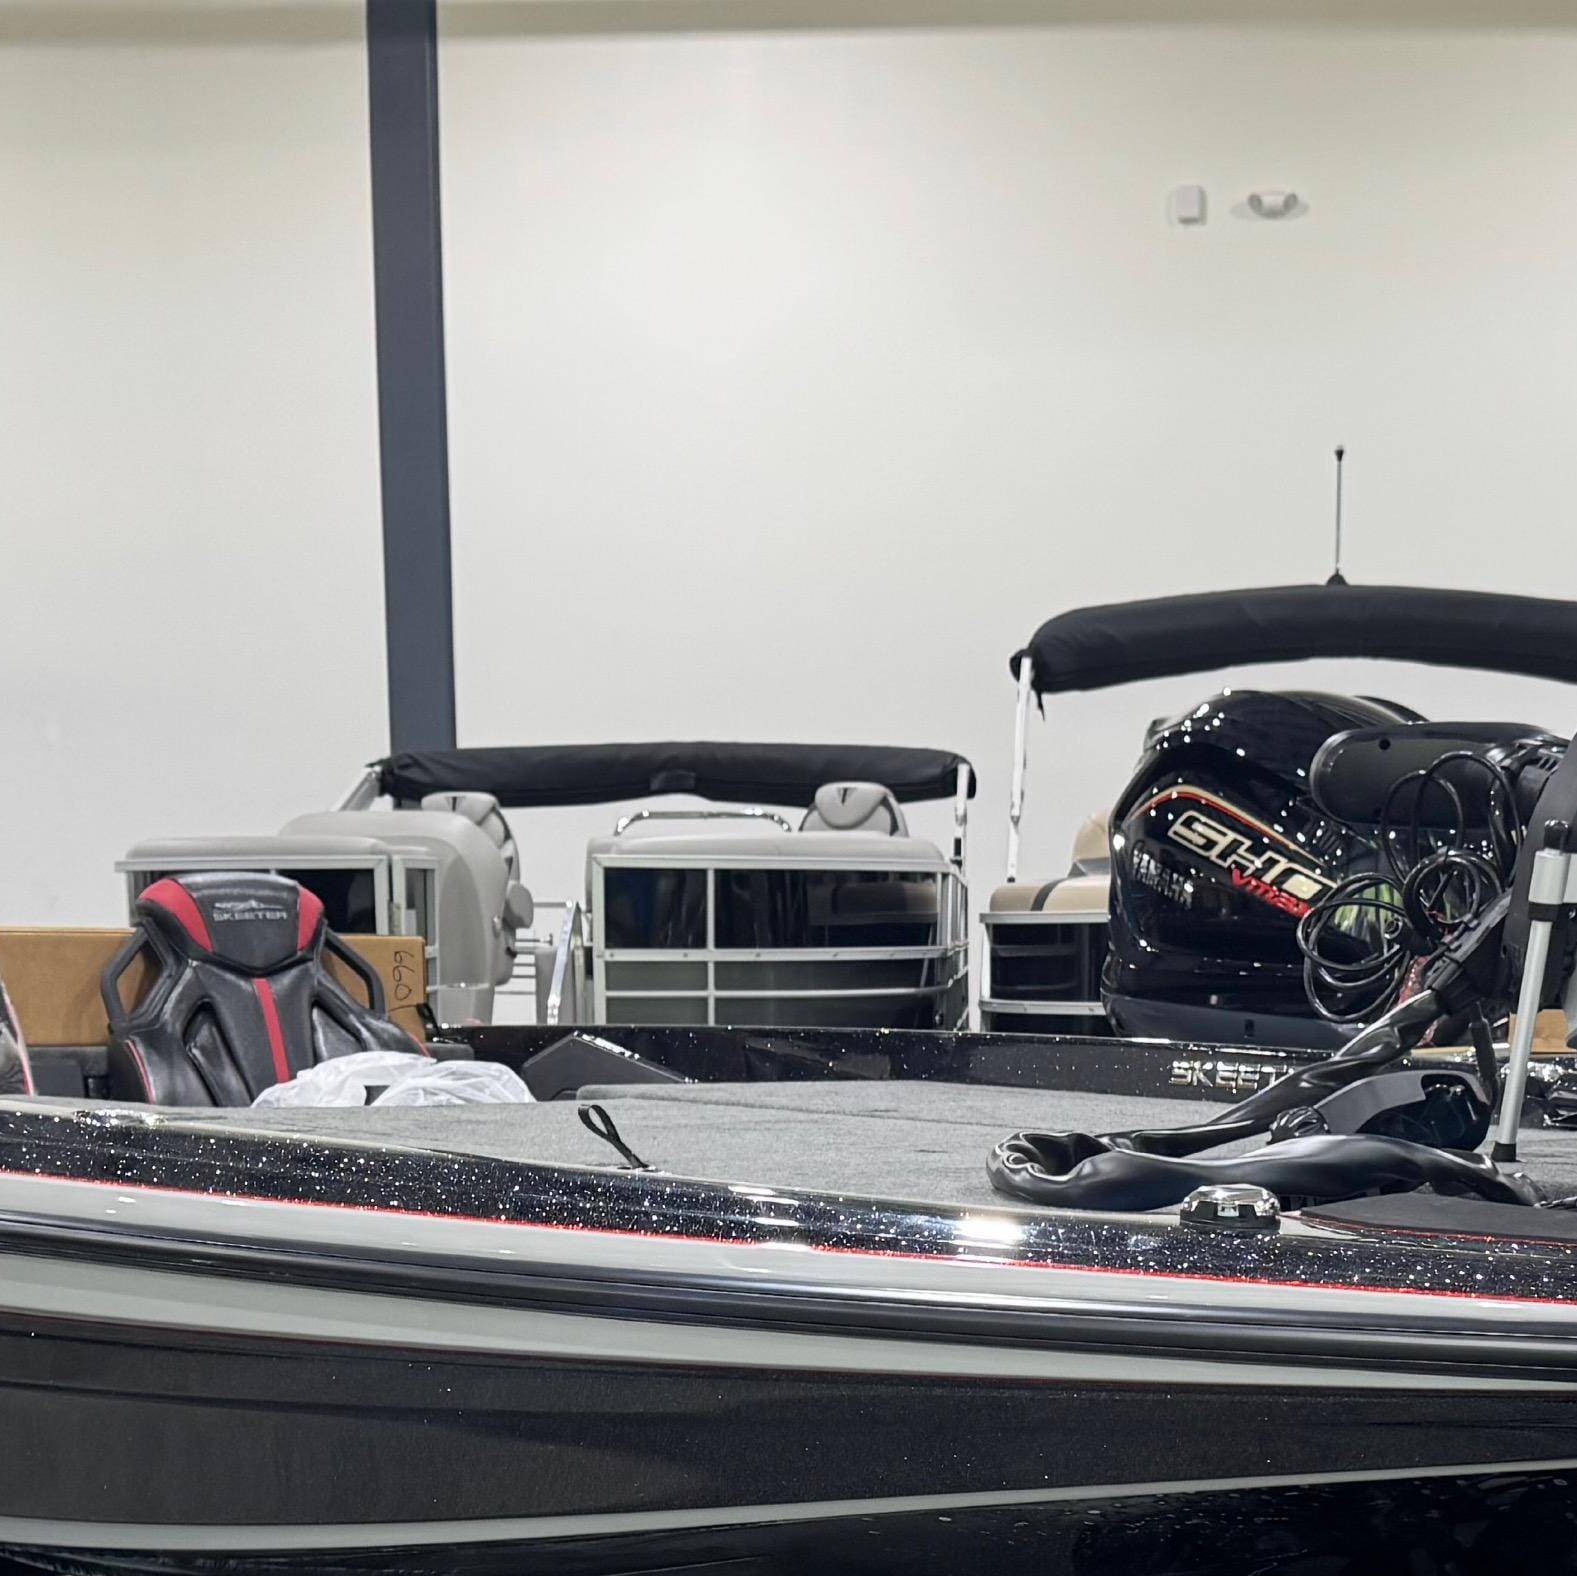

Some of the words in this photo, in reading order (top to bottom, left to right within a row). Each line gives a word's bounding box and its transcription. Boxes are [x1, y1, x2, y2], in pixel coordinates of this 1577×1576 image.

[1167, 810, 1338, 900] SHO
[213, 911, 287, 921] SKEETER
[1171, 1060, 1294, 1089] SKEET
